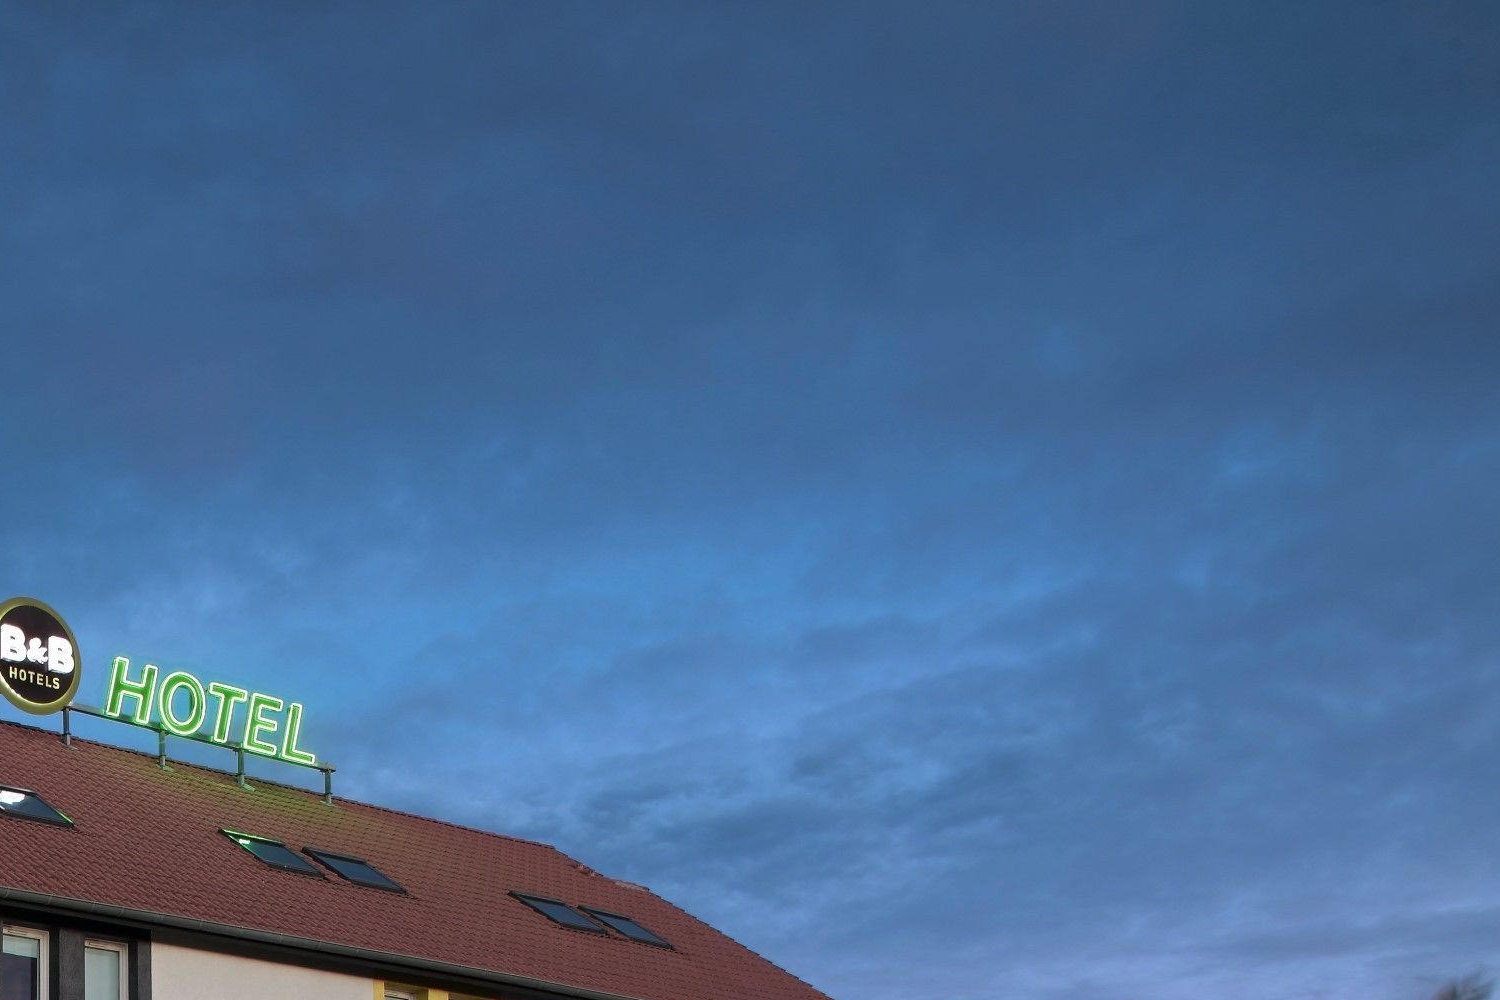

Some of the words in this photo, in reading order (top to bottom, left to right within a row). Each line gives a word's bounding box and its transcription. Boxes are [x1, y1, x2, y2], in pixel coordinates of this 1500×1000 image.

[0, 623, 75, 674] B&B
[9, 666, 60, 690] HOTELS
[105, 656, 315, 764] HOTEL
